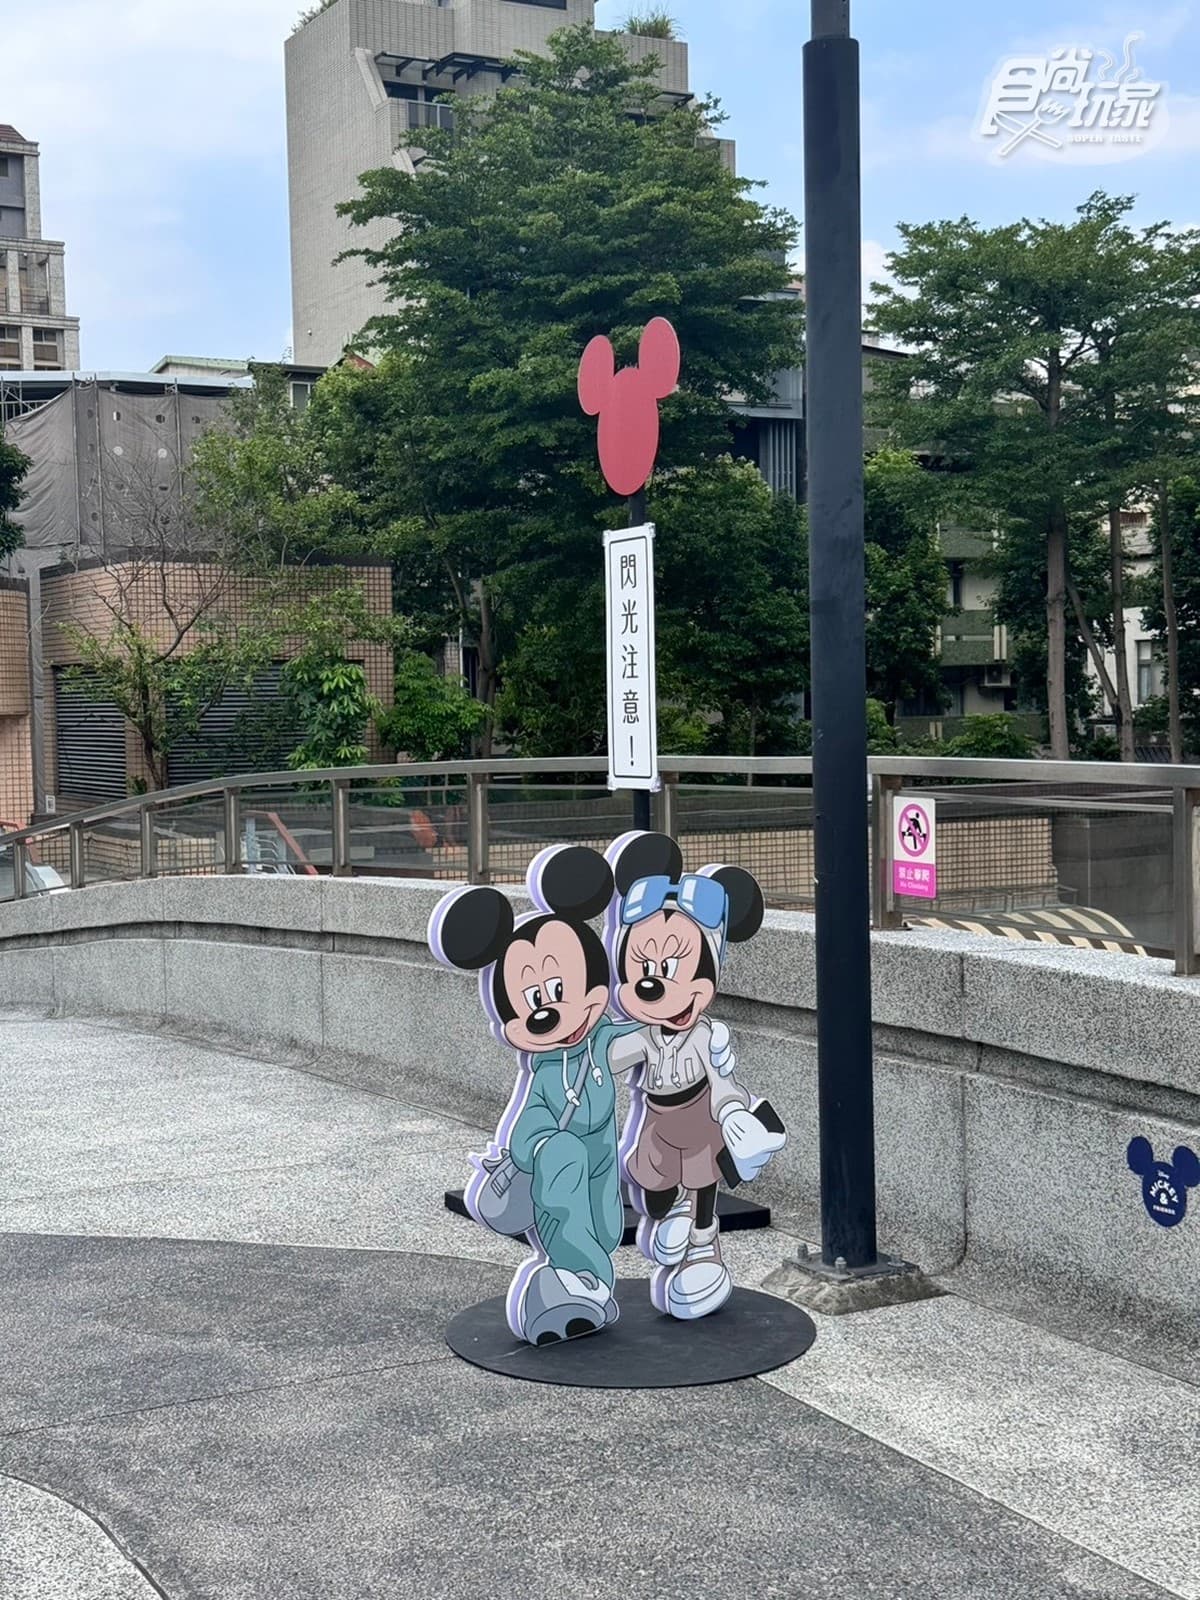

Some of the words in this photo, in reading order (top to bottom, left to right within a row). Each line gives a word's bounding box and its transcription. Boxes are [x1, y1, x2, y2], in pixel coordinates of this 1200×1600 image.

[620, 554, 640, 767] 閃光注意！
[1149, 1180, 1179, 1203] MICKEY
[1159, 1192, 1169, 1205] &
